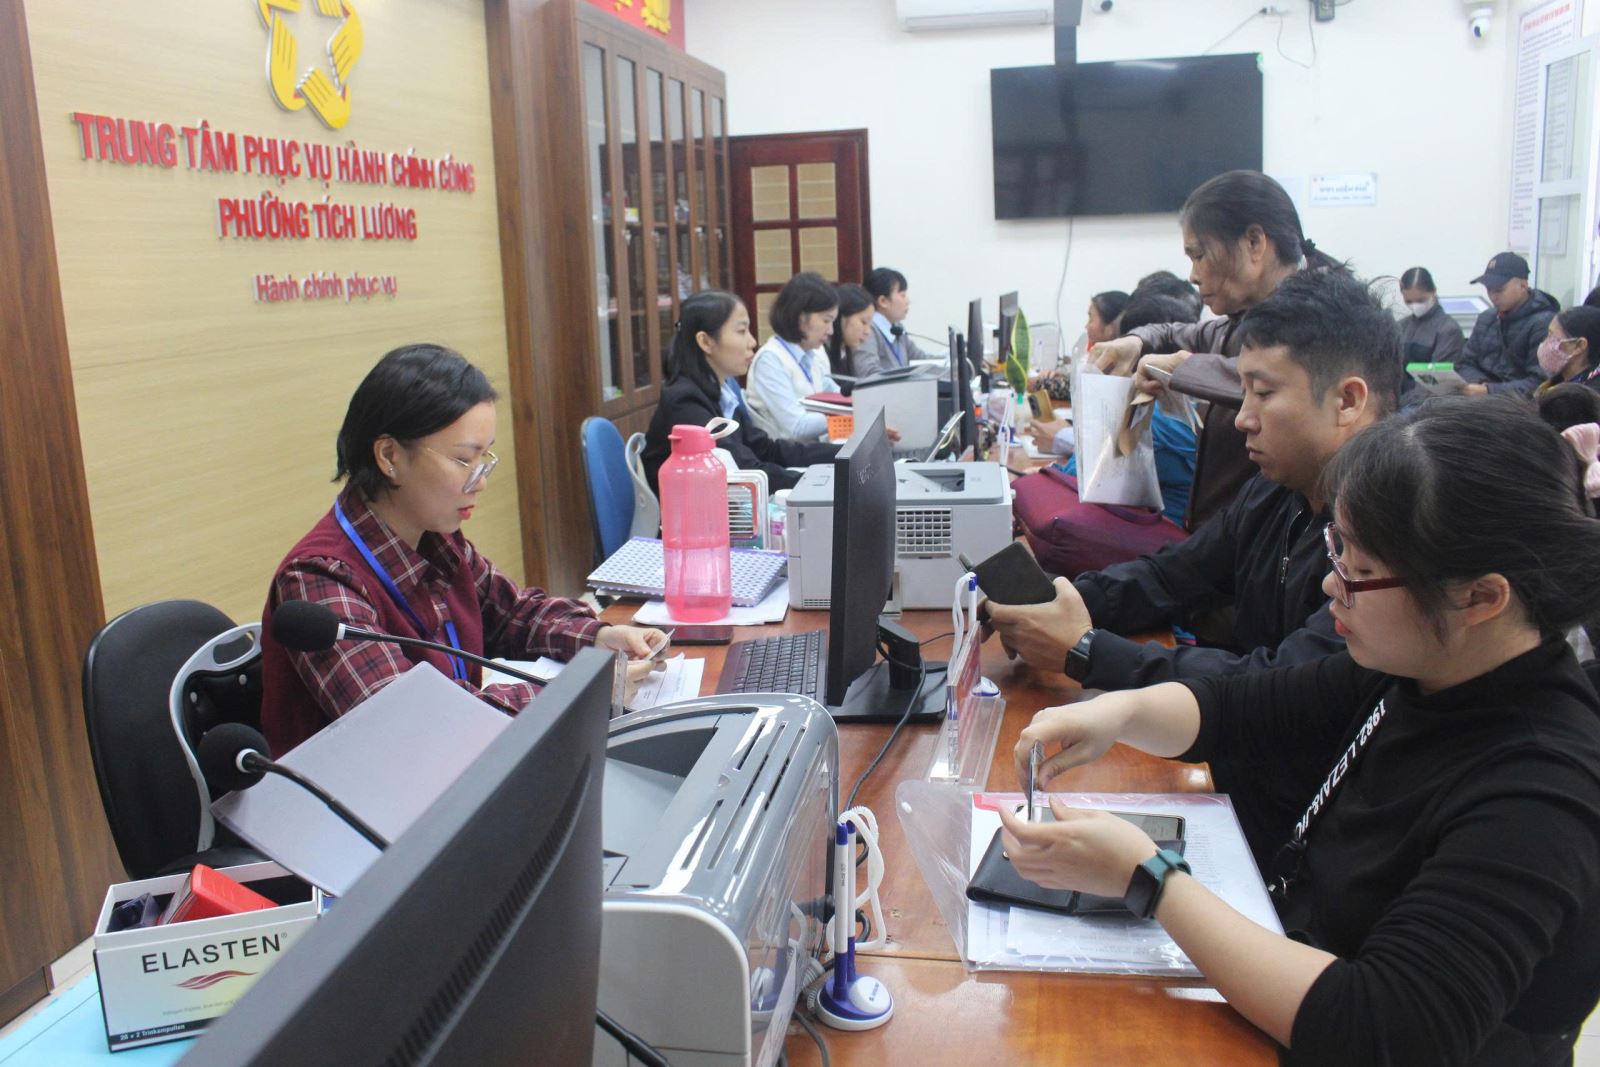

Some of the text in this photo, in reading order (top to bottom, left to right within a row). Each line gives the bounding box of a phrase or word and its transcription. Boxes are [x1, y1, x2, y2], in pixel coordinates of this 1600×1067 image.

[71, 112, 475, 193] TRUNG TÂM PHỤC VỤ HÀNH CHÍNH CÔNG
[217, 190, 418, 240] PHƯỜNG TÍCH LƯƠNG
[255, 271, 397, 302] Hành chính phục vụ
